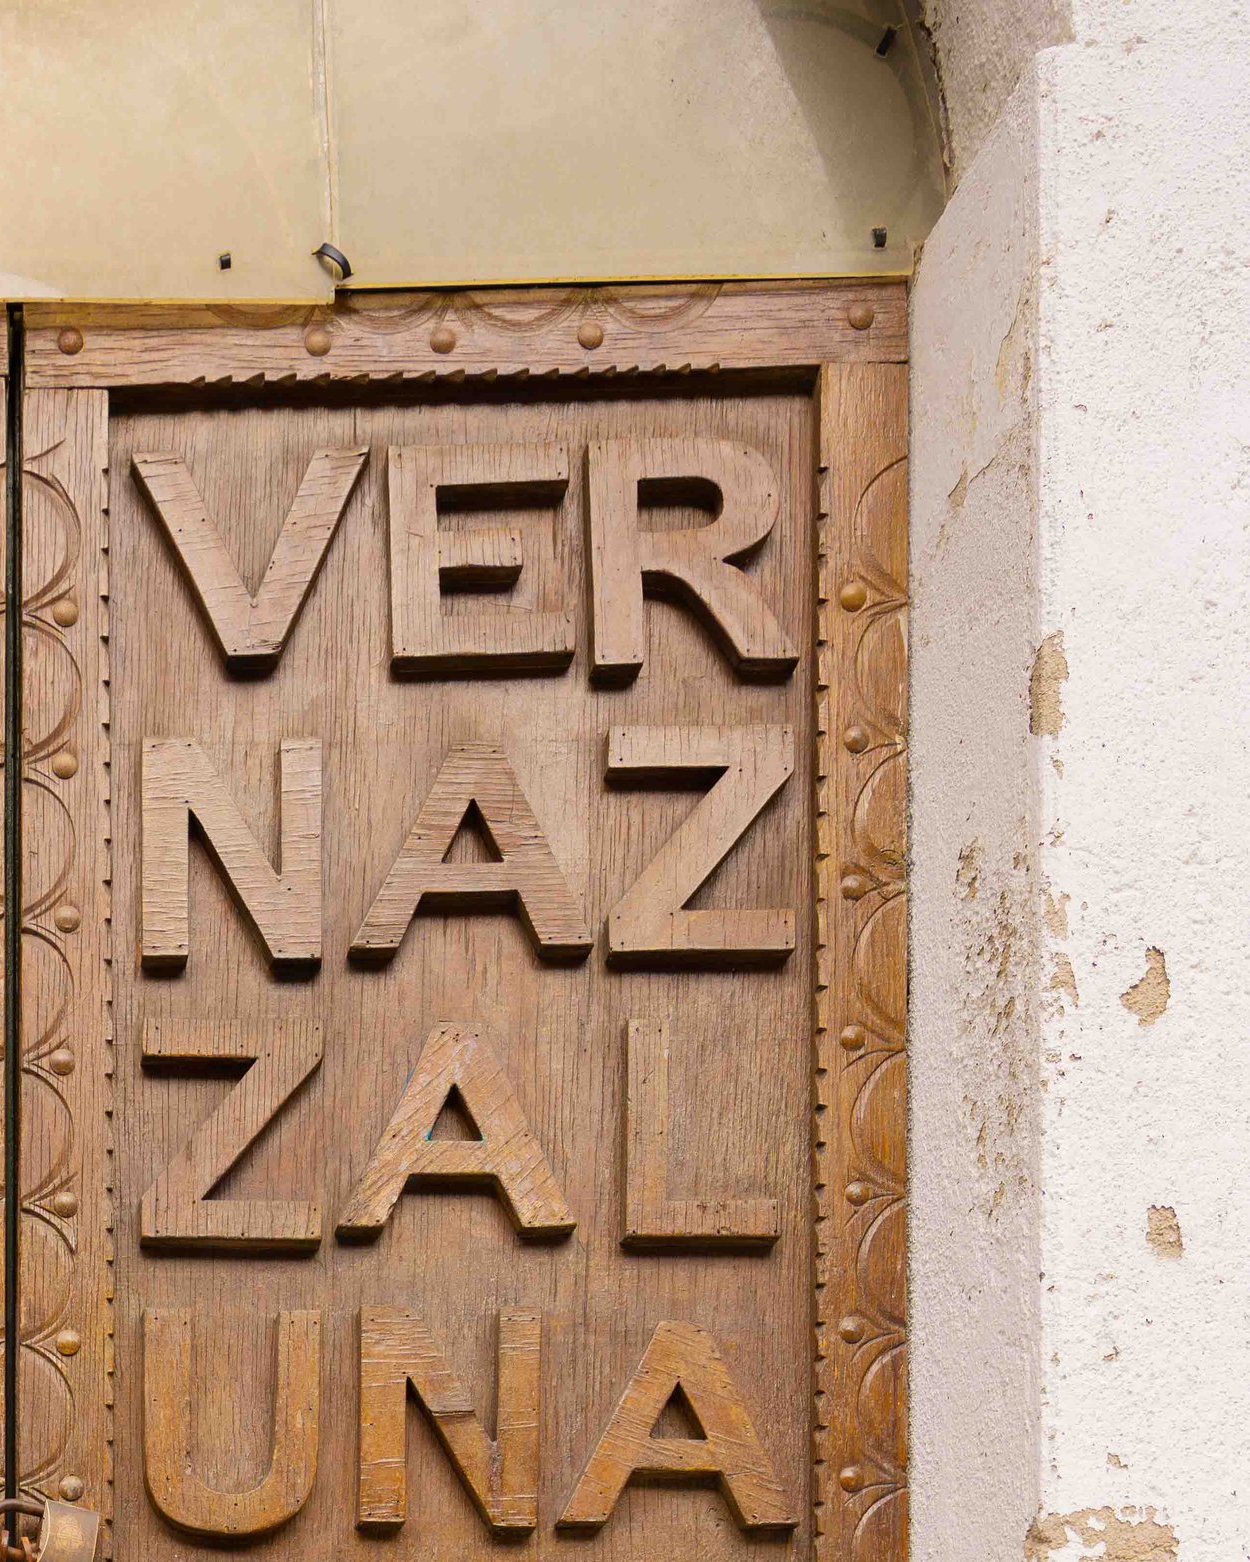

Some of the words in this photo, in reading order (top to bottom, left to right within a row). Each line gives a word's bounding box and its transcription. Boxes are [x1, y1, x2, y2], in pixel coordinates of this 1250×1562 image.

[130, 436, 799, 682] VER
[140, 724, 796, 972] NAZ
[139, 1017, 782, 1254] ZAL
[142, 1305, 798, 1537] UNA
